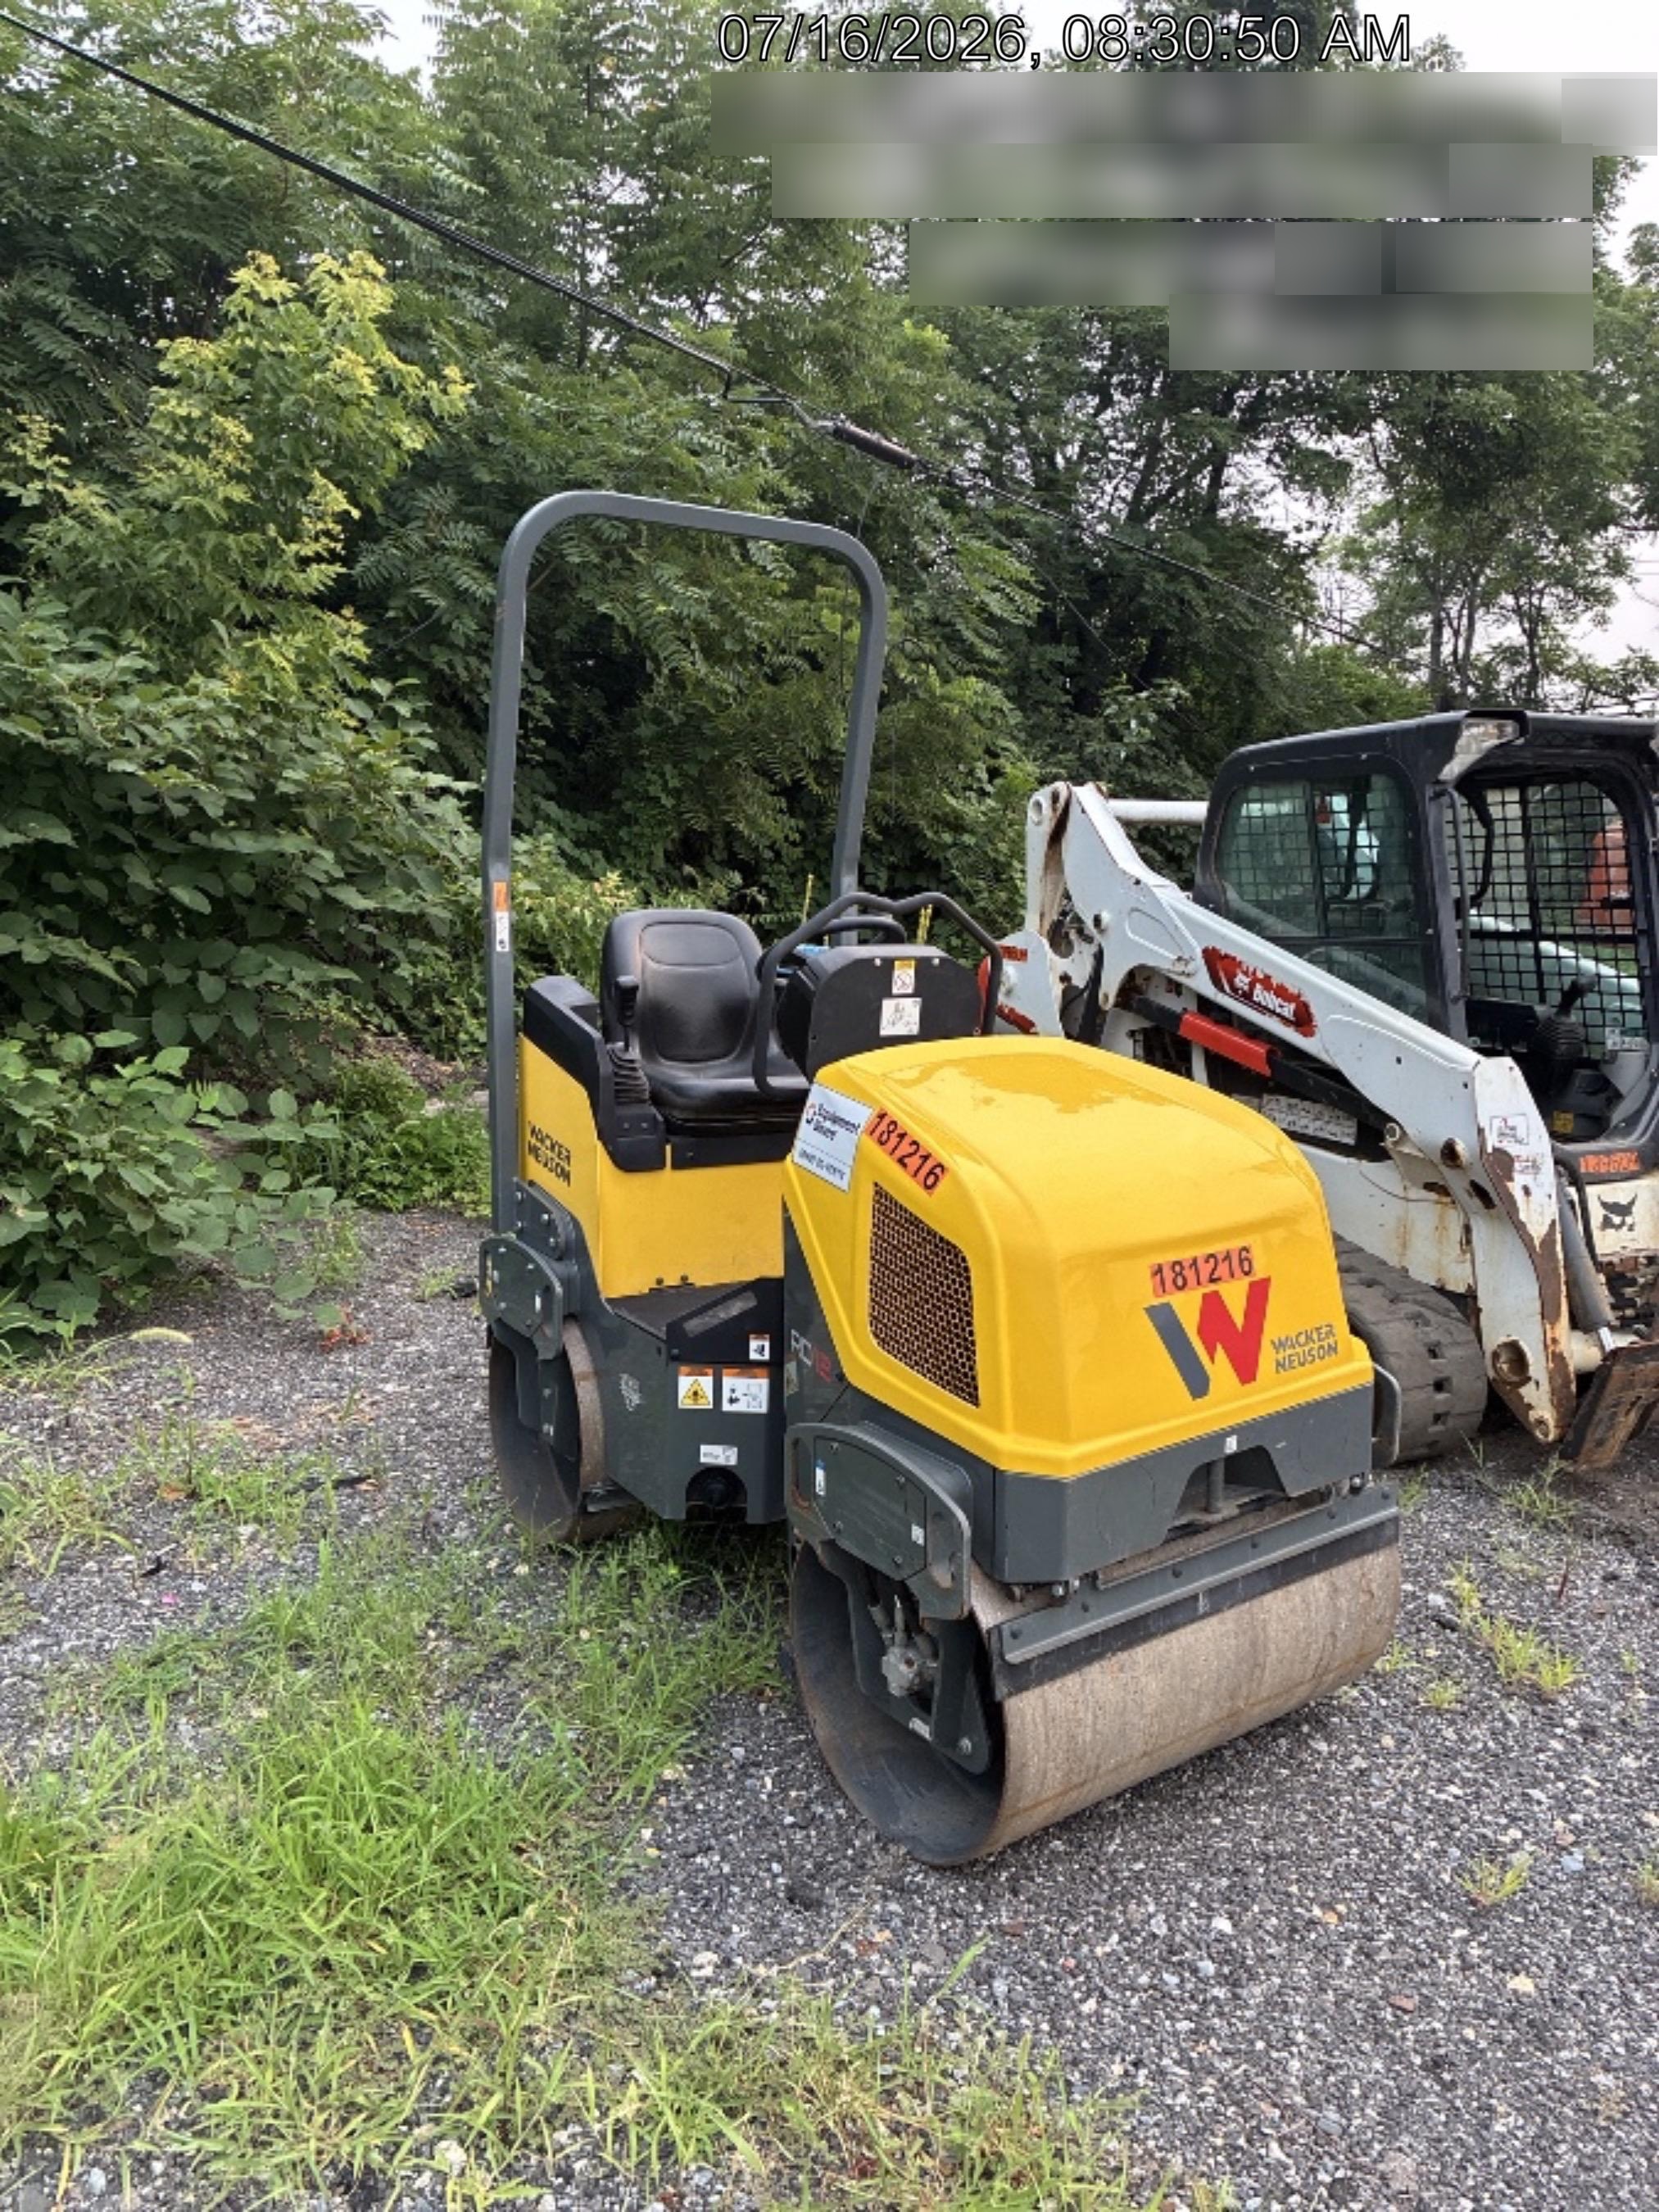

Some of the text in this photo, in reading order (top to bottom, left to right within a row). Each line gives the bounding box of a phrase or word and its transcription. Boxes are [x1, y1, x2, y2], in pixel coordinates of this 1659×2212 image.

[1253, 982, 1296, 1021] Bobcat
[868, 1110, 946, 1192] 181216
[1154, 1245, 1253, 1294] 181216
[1271, 1322, 1336, 1353] WACKER
[1275, 1341, 1339, 1374] NEUSON
